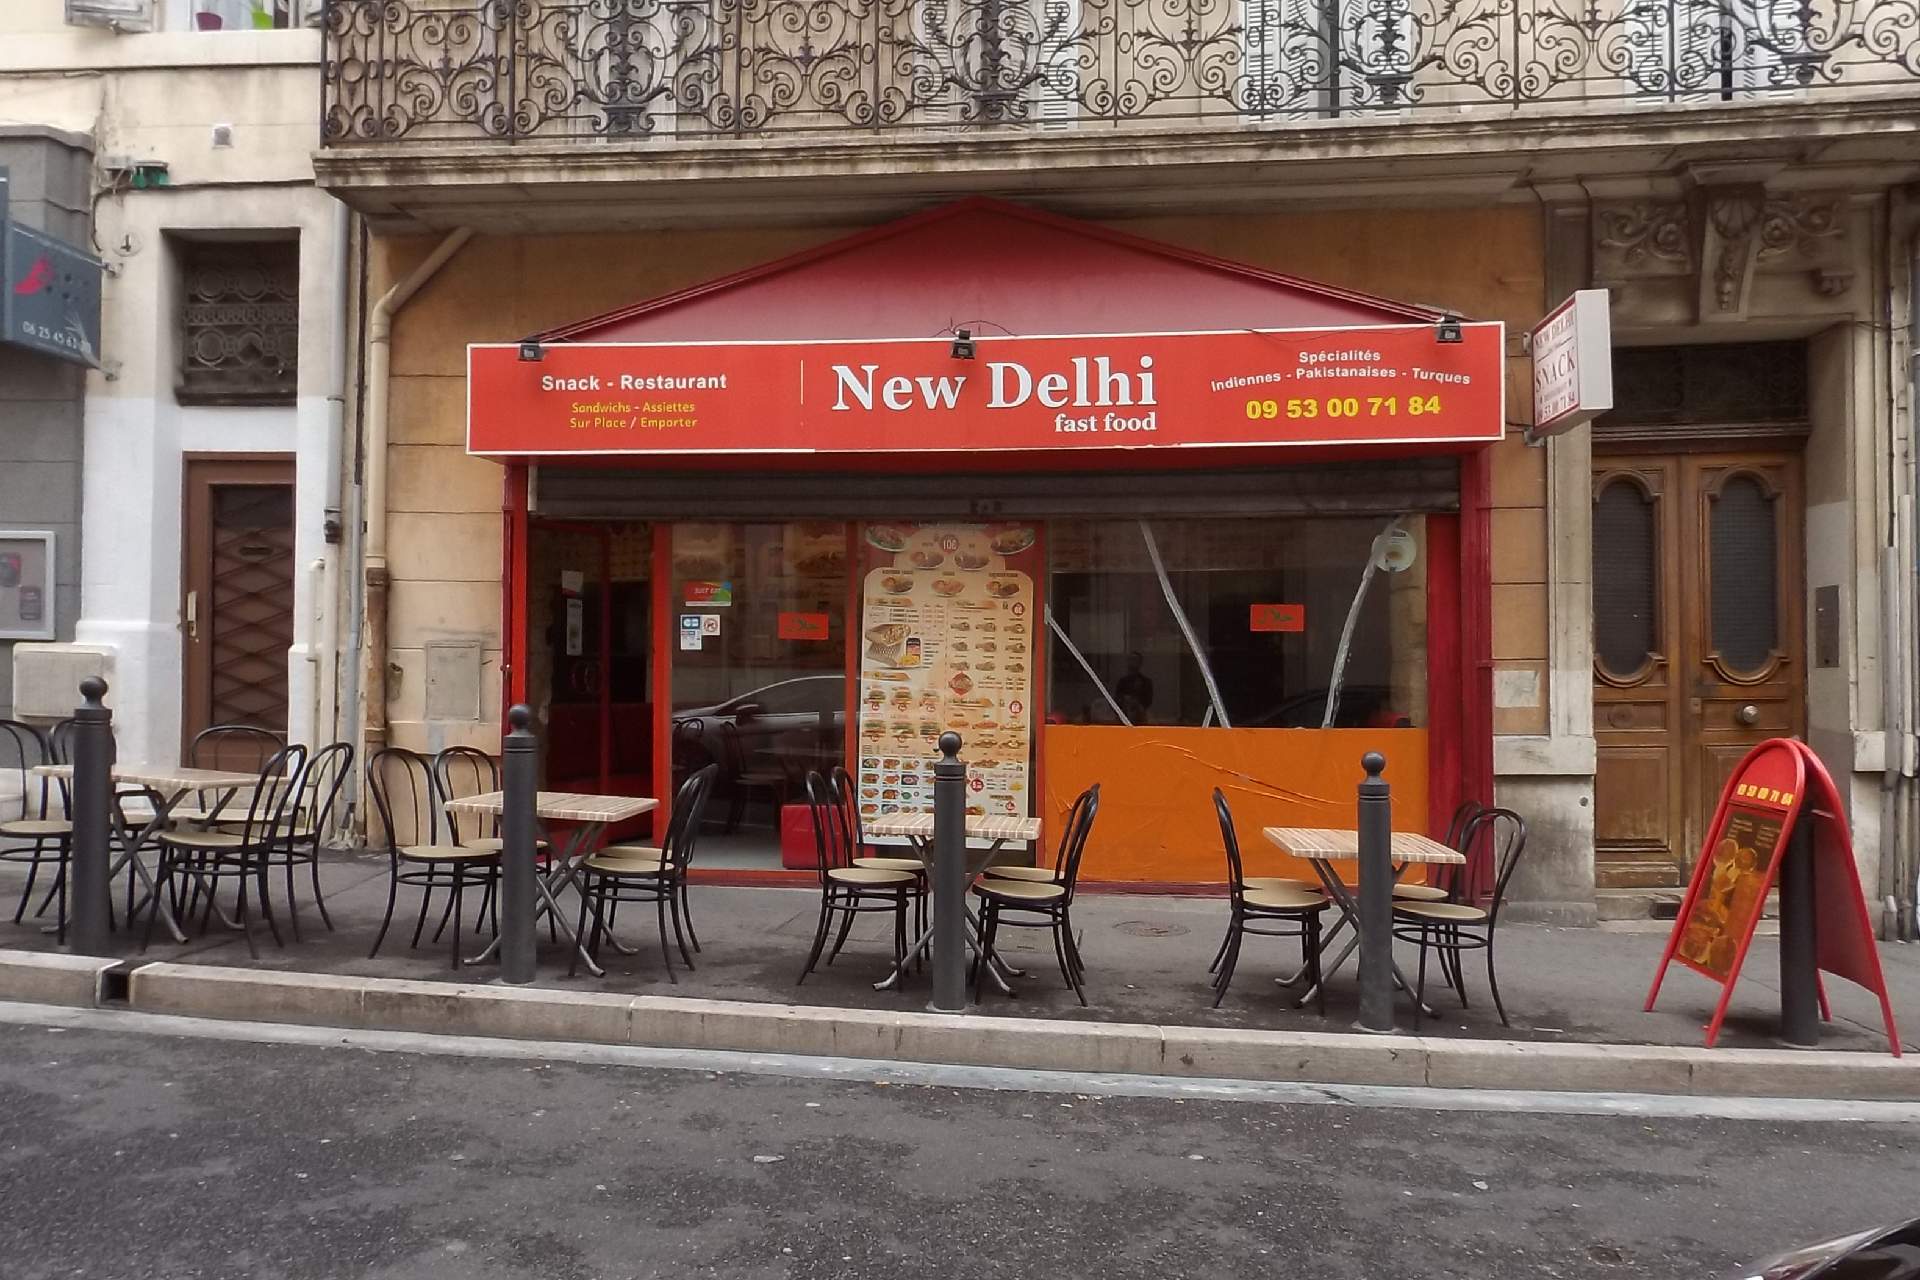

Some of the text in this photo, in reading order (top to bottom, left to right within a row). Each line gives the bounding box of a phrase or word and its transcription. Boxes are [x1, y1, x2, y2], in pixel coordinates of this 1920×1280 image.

[1299, 349, 1381, 366] Spécialités
[1210, 372, 1282, 393] Indiennes
[1295, 365, 1397, 380] Pakistanaises
[1411, 367, 1471, 385] Turques
[1536, 349, 1576, 392] SNACK
[542, 375, 601, 391] Snack
[620, 373, 727, 390] Restaurant
[831, 355, 1158, 411] New Delhi
[572, 401, 631, 413] Sandwichs
[642, 401, 695, 413] Assiettes
[1246, 395, 1441, 419] 09 53 00 71 84
[569, 417, 591, 428] Sur
[594, 416, 626, 428] Place
[640, 416, 698, 431] Emporter
[1054, 411, 1158, 433] fast food
